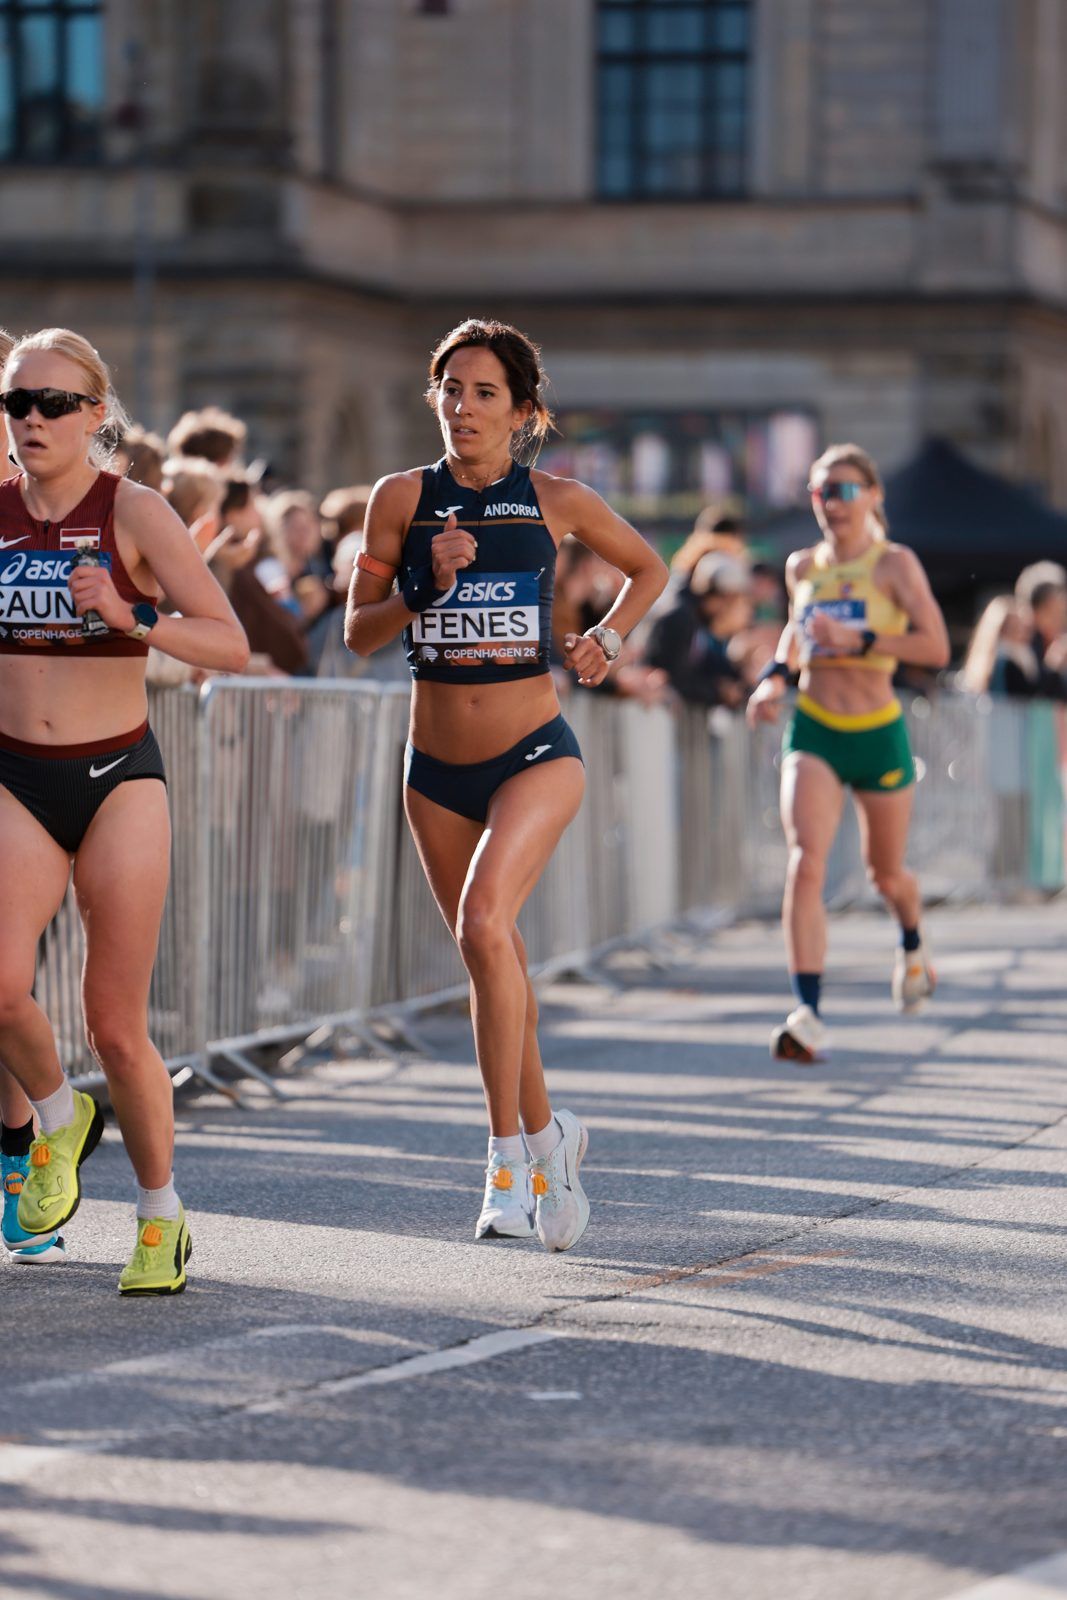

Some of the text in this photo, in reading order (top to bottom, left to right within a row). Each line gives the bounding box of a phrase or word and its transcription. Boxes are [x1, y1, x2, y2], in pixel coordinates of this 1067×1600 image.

[484, 502, 540, 518] ANDORRA
[25, 559, 72, 580] asic
[457, 581, 516, 602] asics
[419, 610, 529, 639] FENES
[12, 628, 82, 640] COPENHAGE
[443, 647, 536, 660] COPENHAGEN 26
